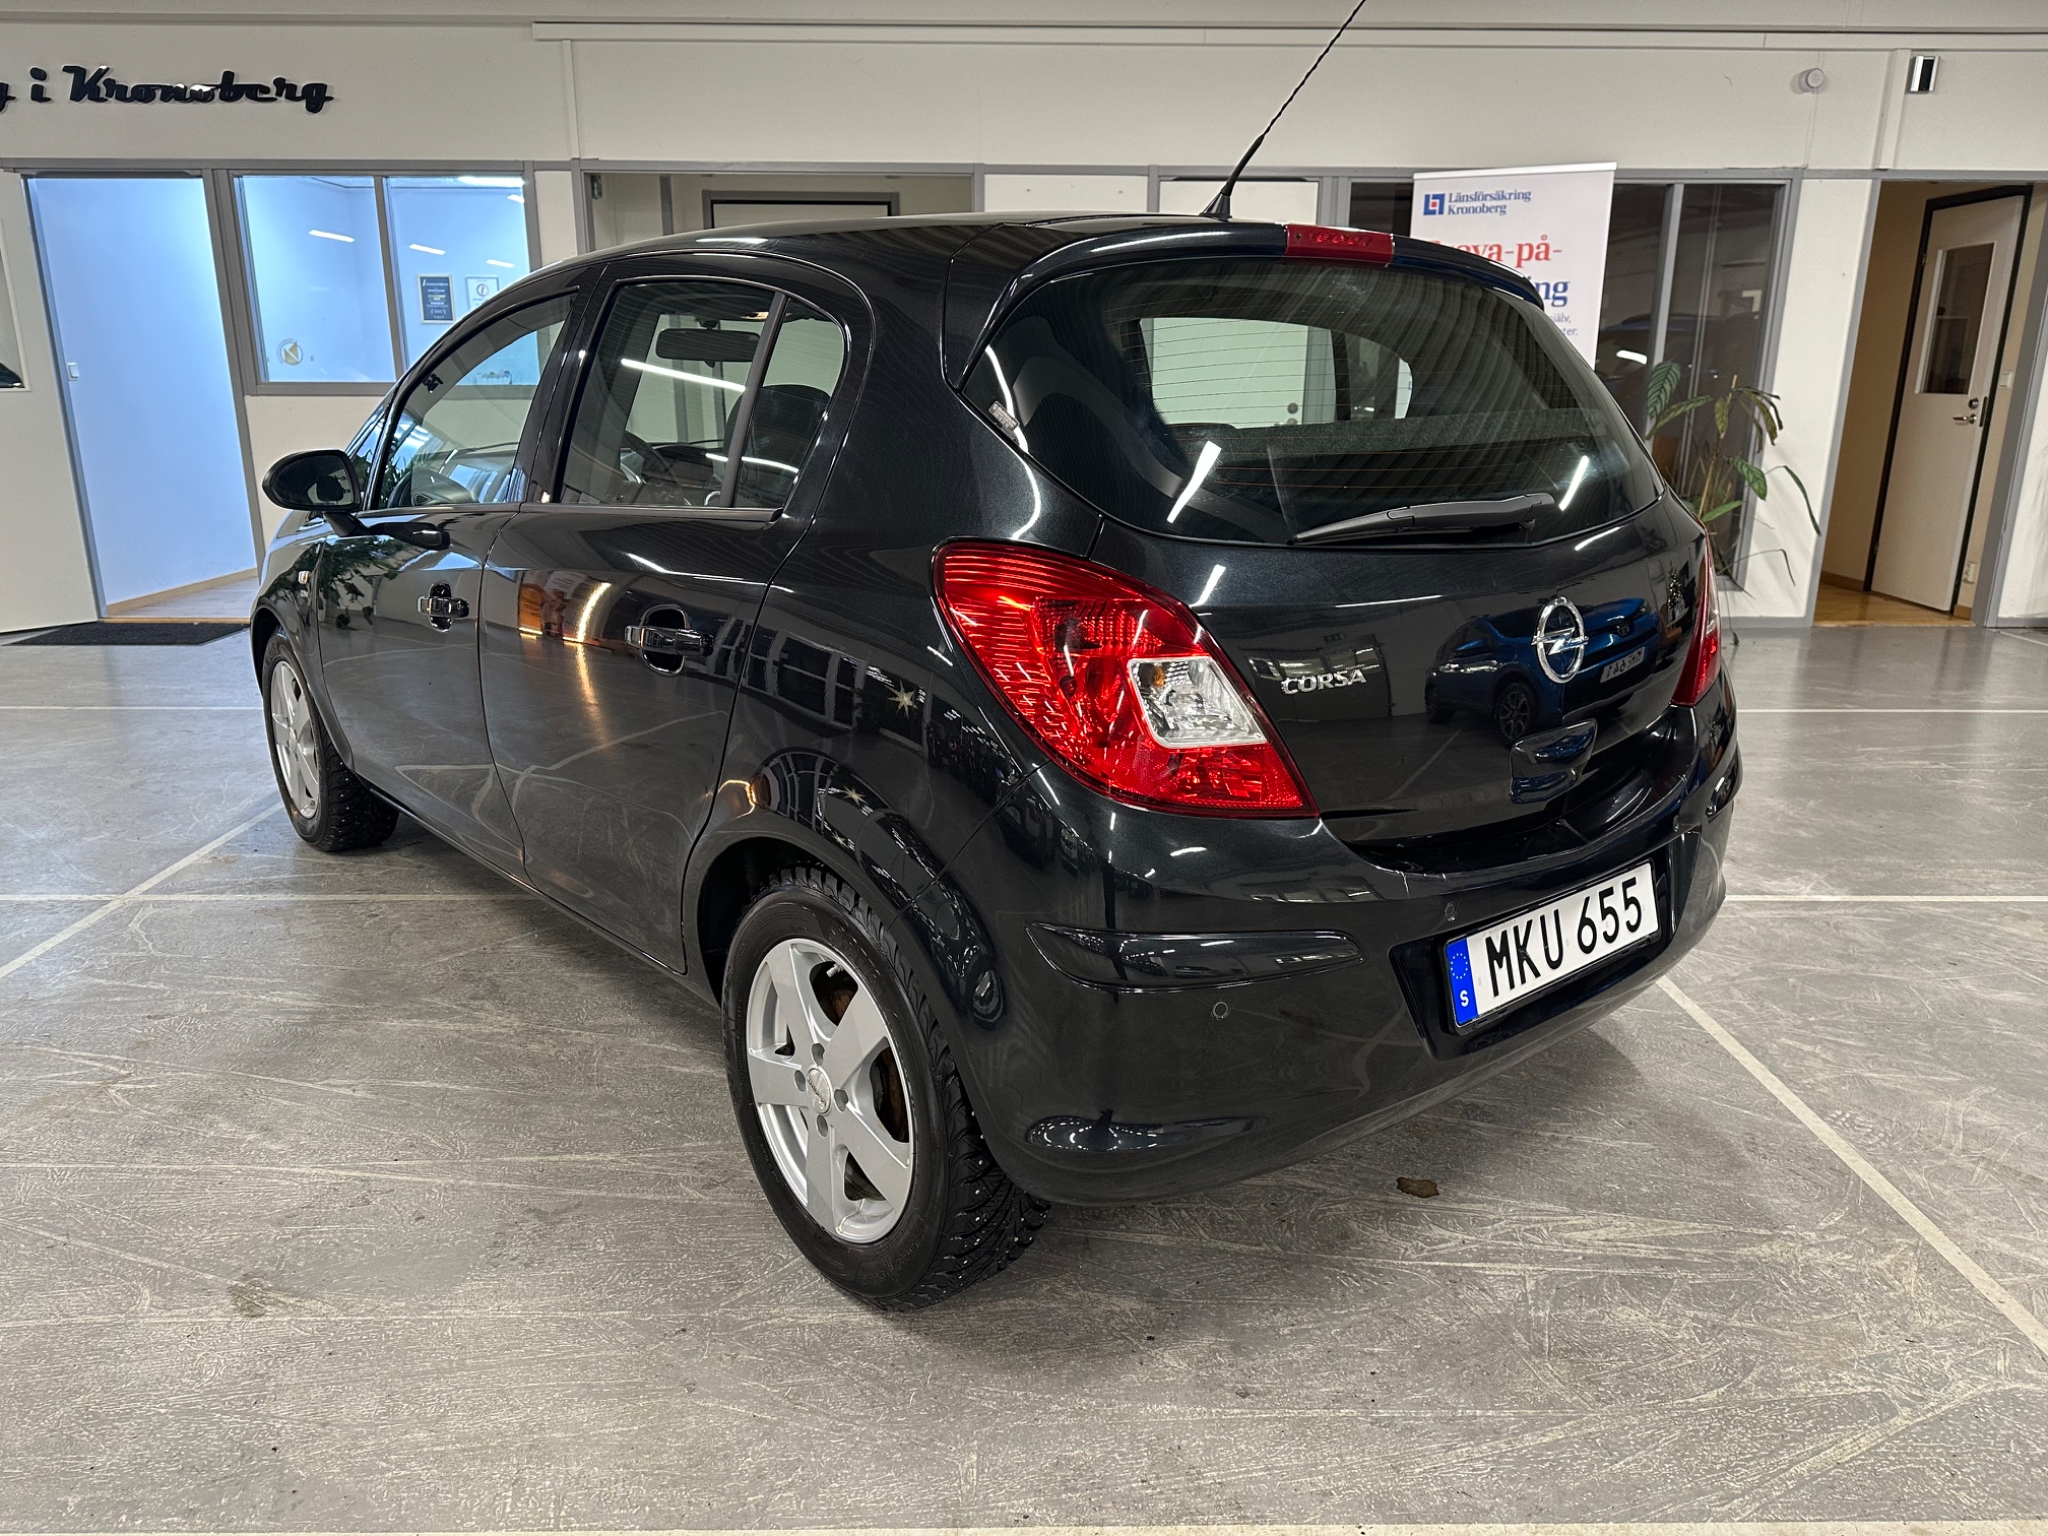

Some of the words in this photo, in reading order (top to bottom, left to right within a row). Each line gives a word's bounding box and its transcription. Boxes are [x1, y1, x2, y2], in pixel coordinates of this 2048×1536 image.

[30, 67, 51, 102] i
[62, 65, 334, 113] Kronoberg
[1448, 190, 1531, 202] Länsförsäkring
[1448, 203, 1507, 215] Kronoberg
[1281, 669, 1367, 695] CORSA
[1485, 909, 1564, 997] MKU
[1577, 877, 1642, 954] 655
[1460, 989, 1470, 1007] S
